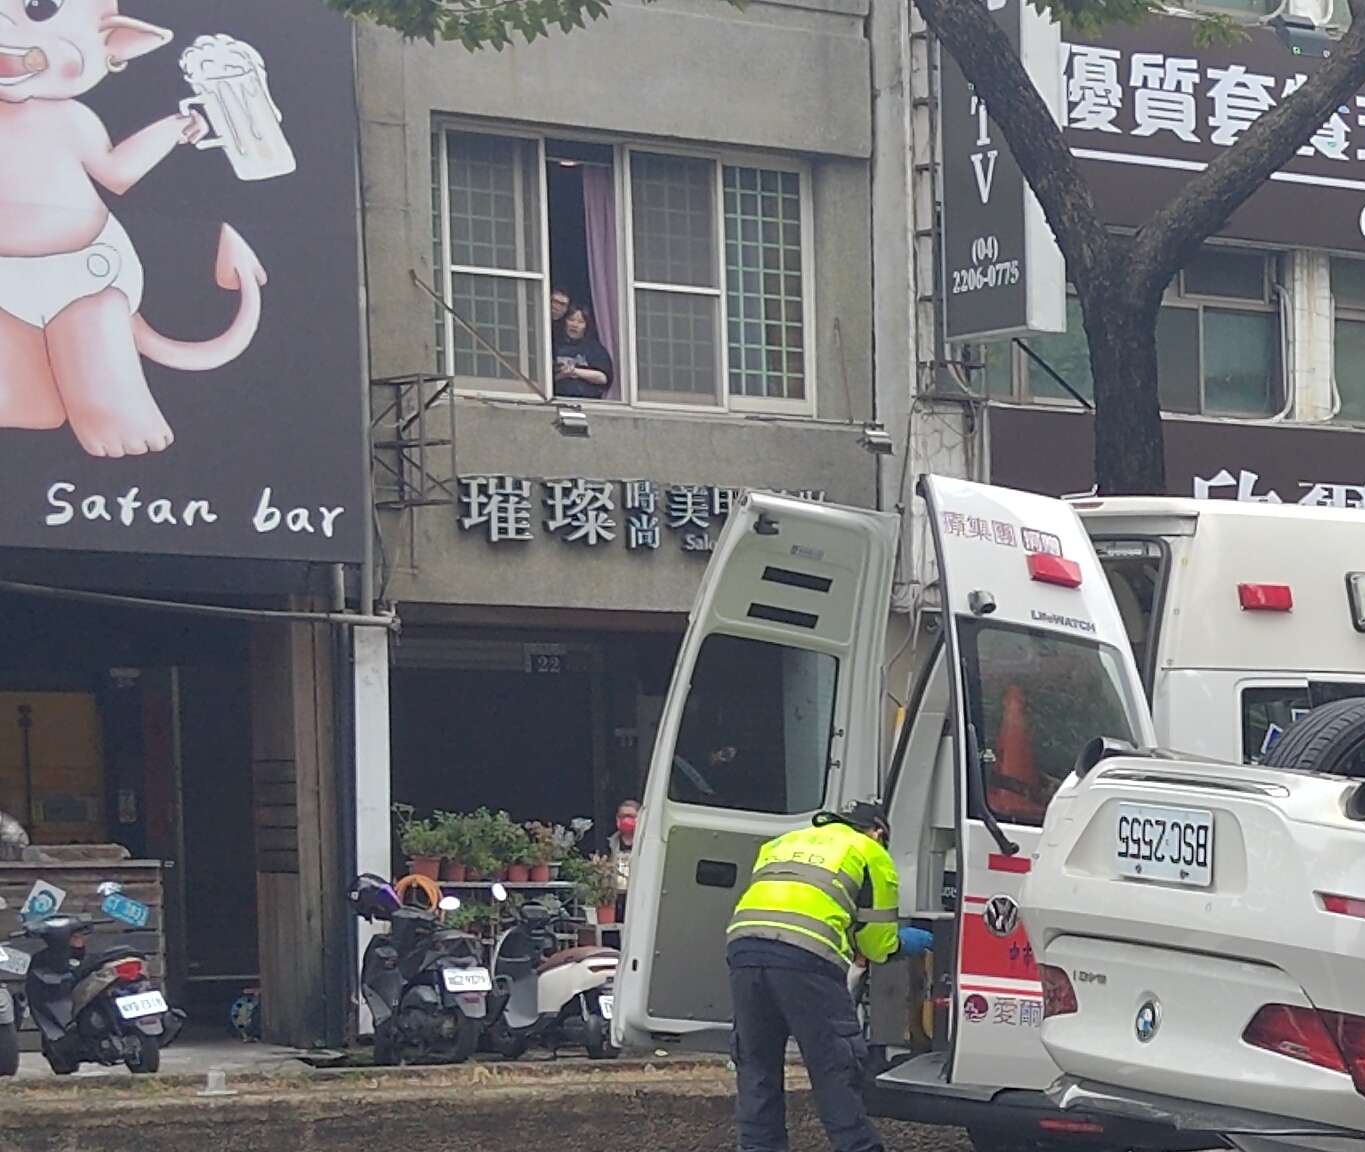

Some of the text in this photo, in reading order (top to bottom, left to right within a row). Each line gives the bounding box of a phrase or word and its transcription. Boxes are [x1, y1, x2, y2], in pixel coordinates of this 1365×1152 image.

[952, 260, 1020, 294] 2206-0775
[45, 482, 346, 538] Satan bar
[458, 475, 618, 546] 璀璨
[624, 480, 661, 550] 時尚
